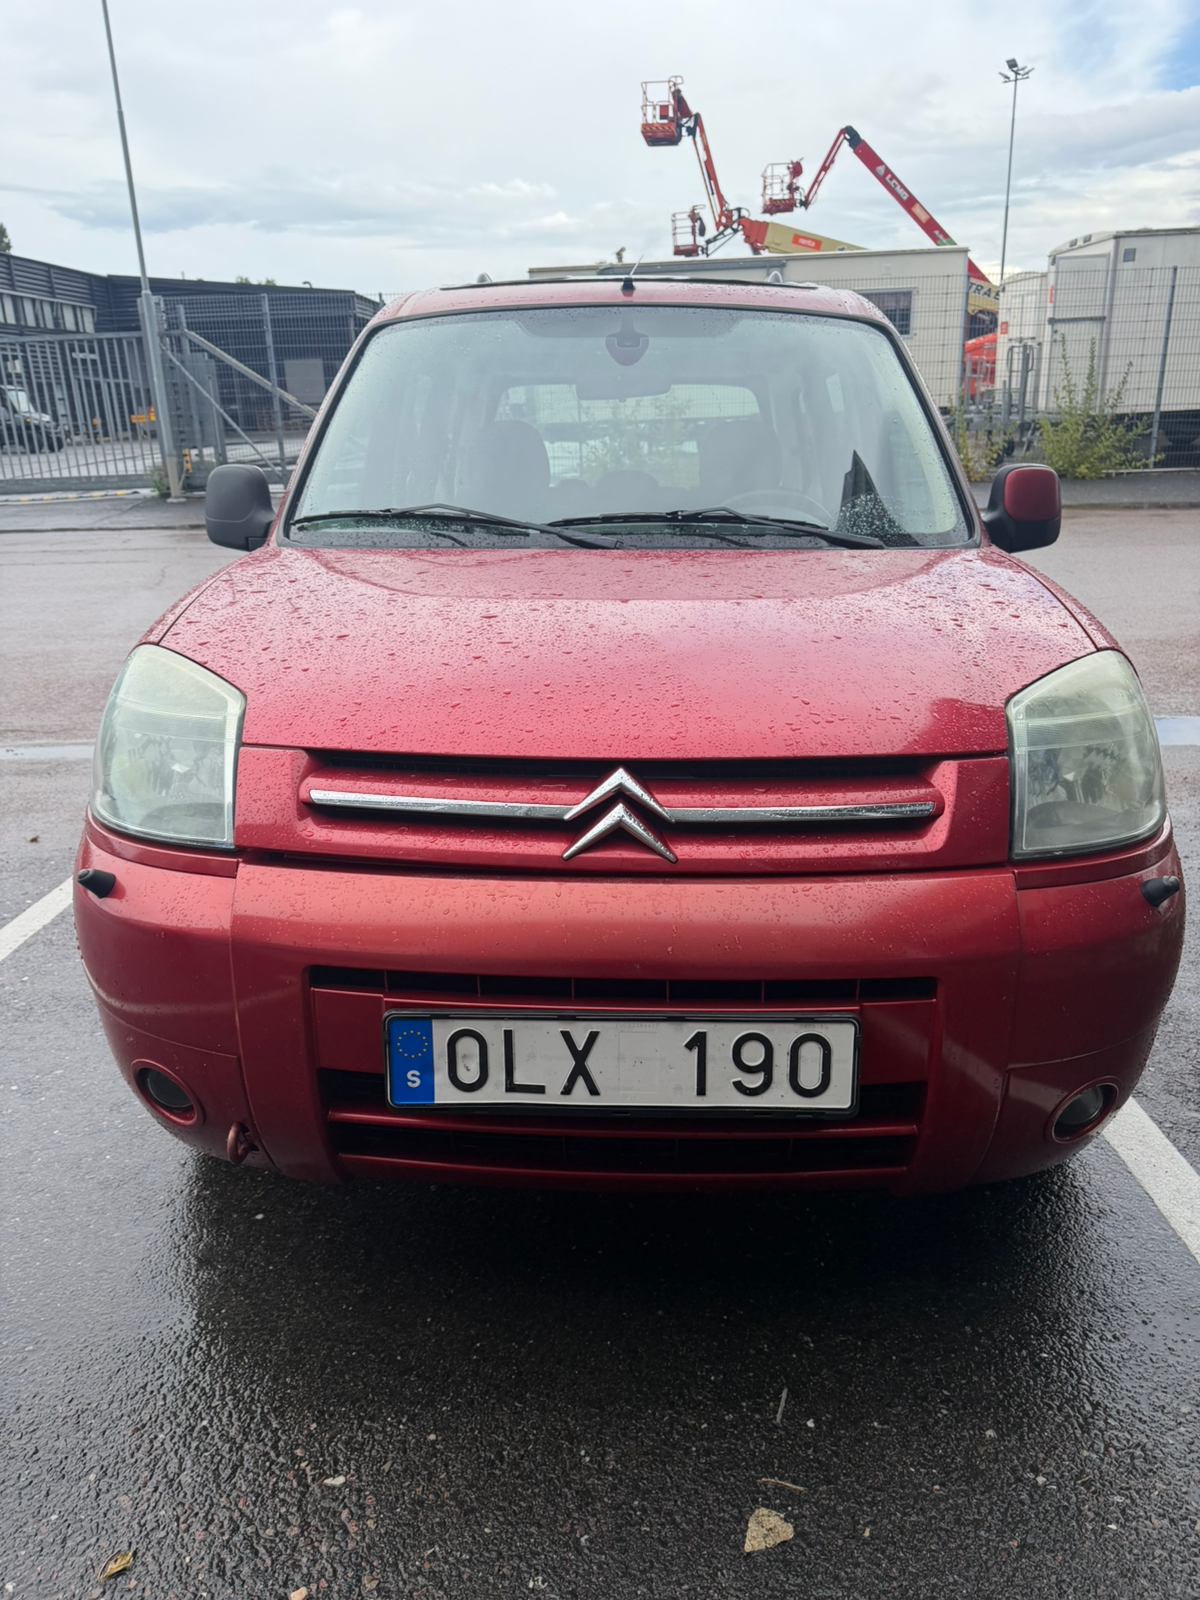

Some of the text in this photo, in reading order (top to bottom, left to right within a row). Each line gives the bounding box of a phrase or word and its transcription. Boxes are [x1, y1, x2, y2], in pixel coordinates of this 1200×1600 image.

[406, 1069, 421, 1088] S
[447, 1028, 832, 1098] OLX 190
